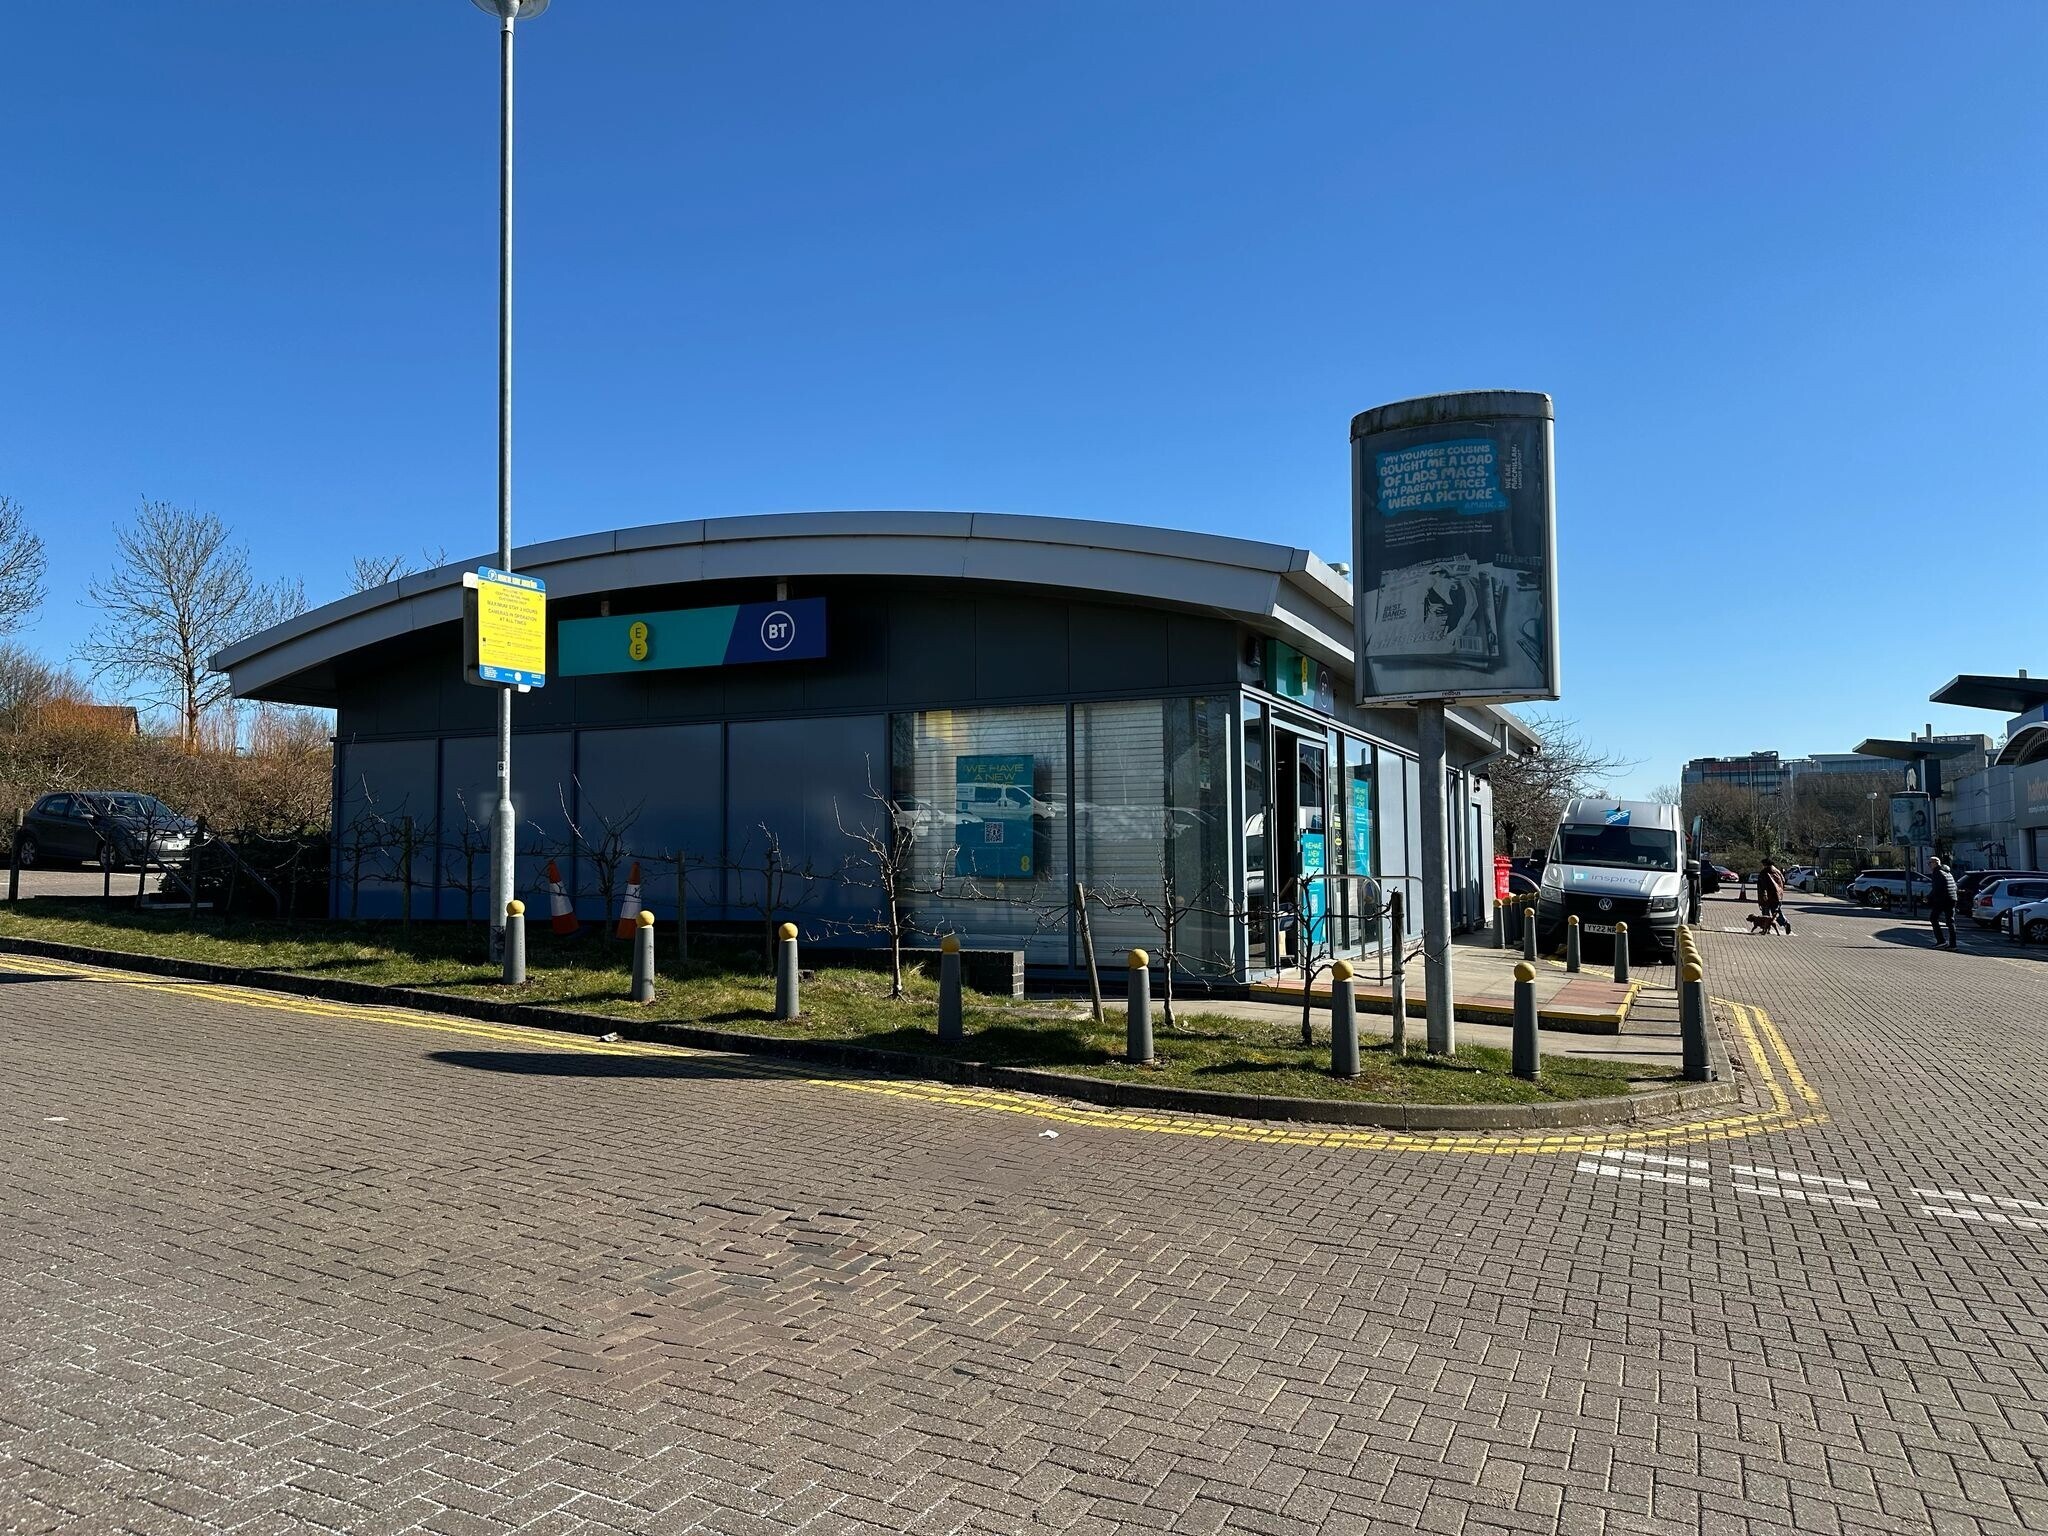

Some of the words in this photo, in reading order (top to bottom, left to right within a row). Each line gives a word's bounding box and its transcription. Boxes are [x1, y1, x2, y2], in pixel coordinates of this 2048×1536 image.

[1399, 448, 1445, 462] YOUNGER
[1447, 444, 1490, 455] COUSINS
[1380, 459, 1426, 477] BOUGHT
[1427, 457, 1447, 468] ME
[1449, 455, 1457, 466] A
[1460, 453, 1493, 465] LOAD
[1384, 474, 1402, 488] OF
[1404, 468, 1438, 484] LADS
[1441, 465, 1489, 480] MAGS.
[1382, 488, 1398, 499] MY
[1455, 478, 1487, 488] FACES
[1388, 494, 1421, 510] WERE
[1424, 492, 1433, 503] A
[768, 622, 788, 640] BT
[498, 763, 504, 771] 6
[966, 764, 986, 773] WE
[989, 763, 1025, 773] HAVE
[986, 773, 1017, 781] NEW
[1587, 924, 1606, 932] YY22
